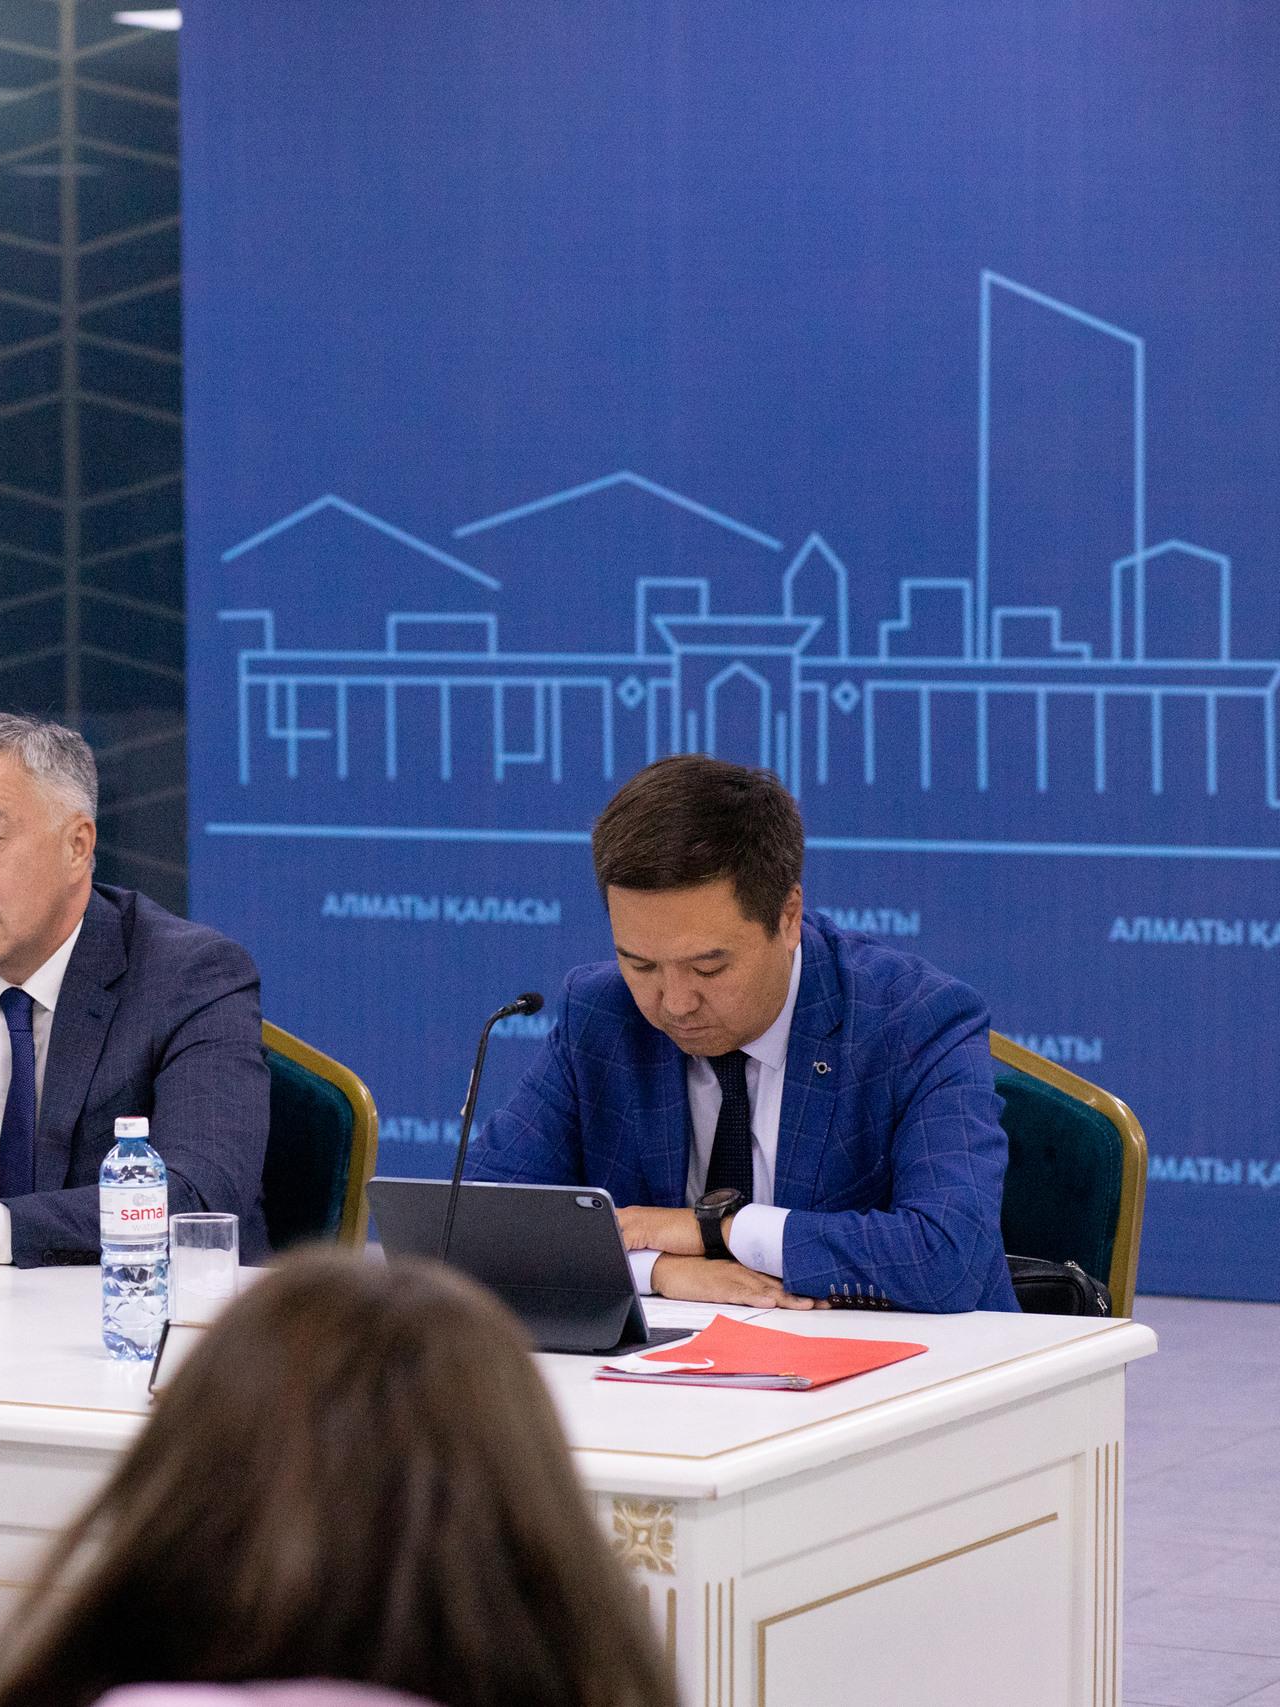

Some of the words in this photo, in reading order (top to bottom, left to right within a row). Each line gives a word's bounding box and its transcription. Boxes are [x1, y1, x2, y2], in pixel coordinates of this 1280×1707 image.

[322, 893, 439, 920] АЛМАТЫ
[443, 896, 561, 925] ҚАЛАСЫ
[816, 906, 920, 937] МАТЫ
[1108, 915, 1244, 946] АЛМАТЫ
[1005, 1034, 1103, 1063] МАТЫ
[1148, 1155, 1243, 1184] МАТЫ
